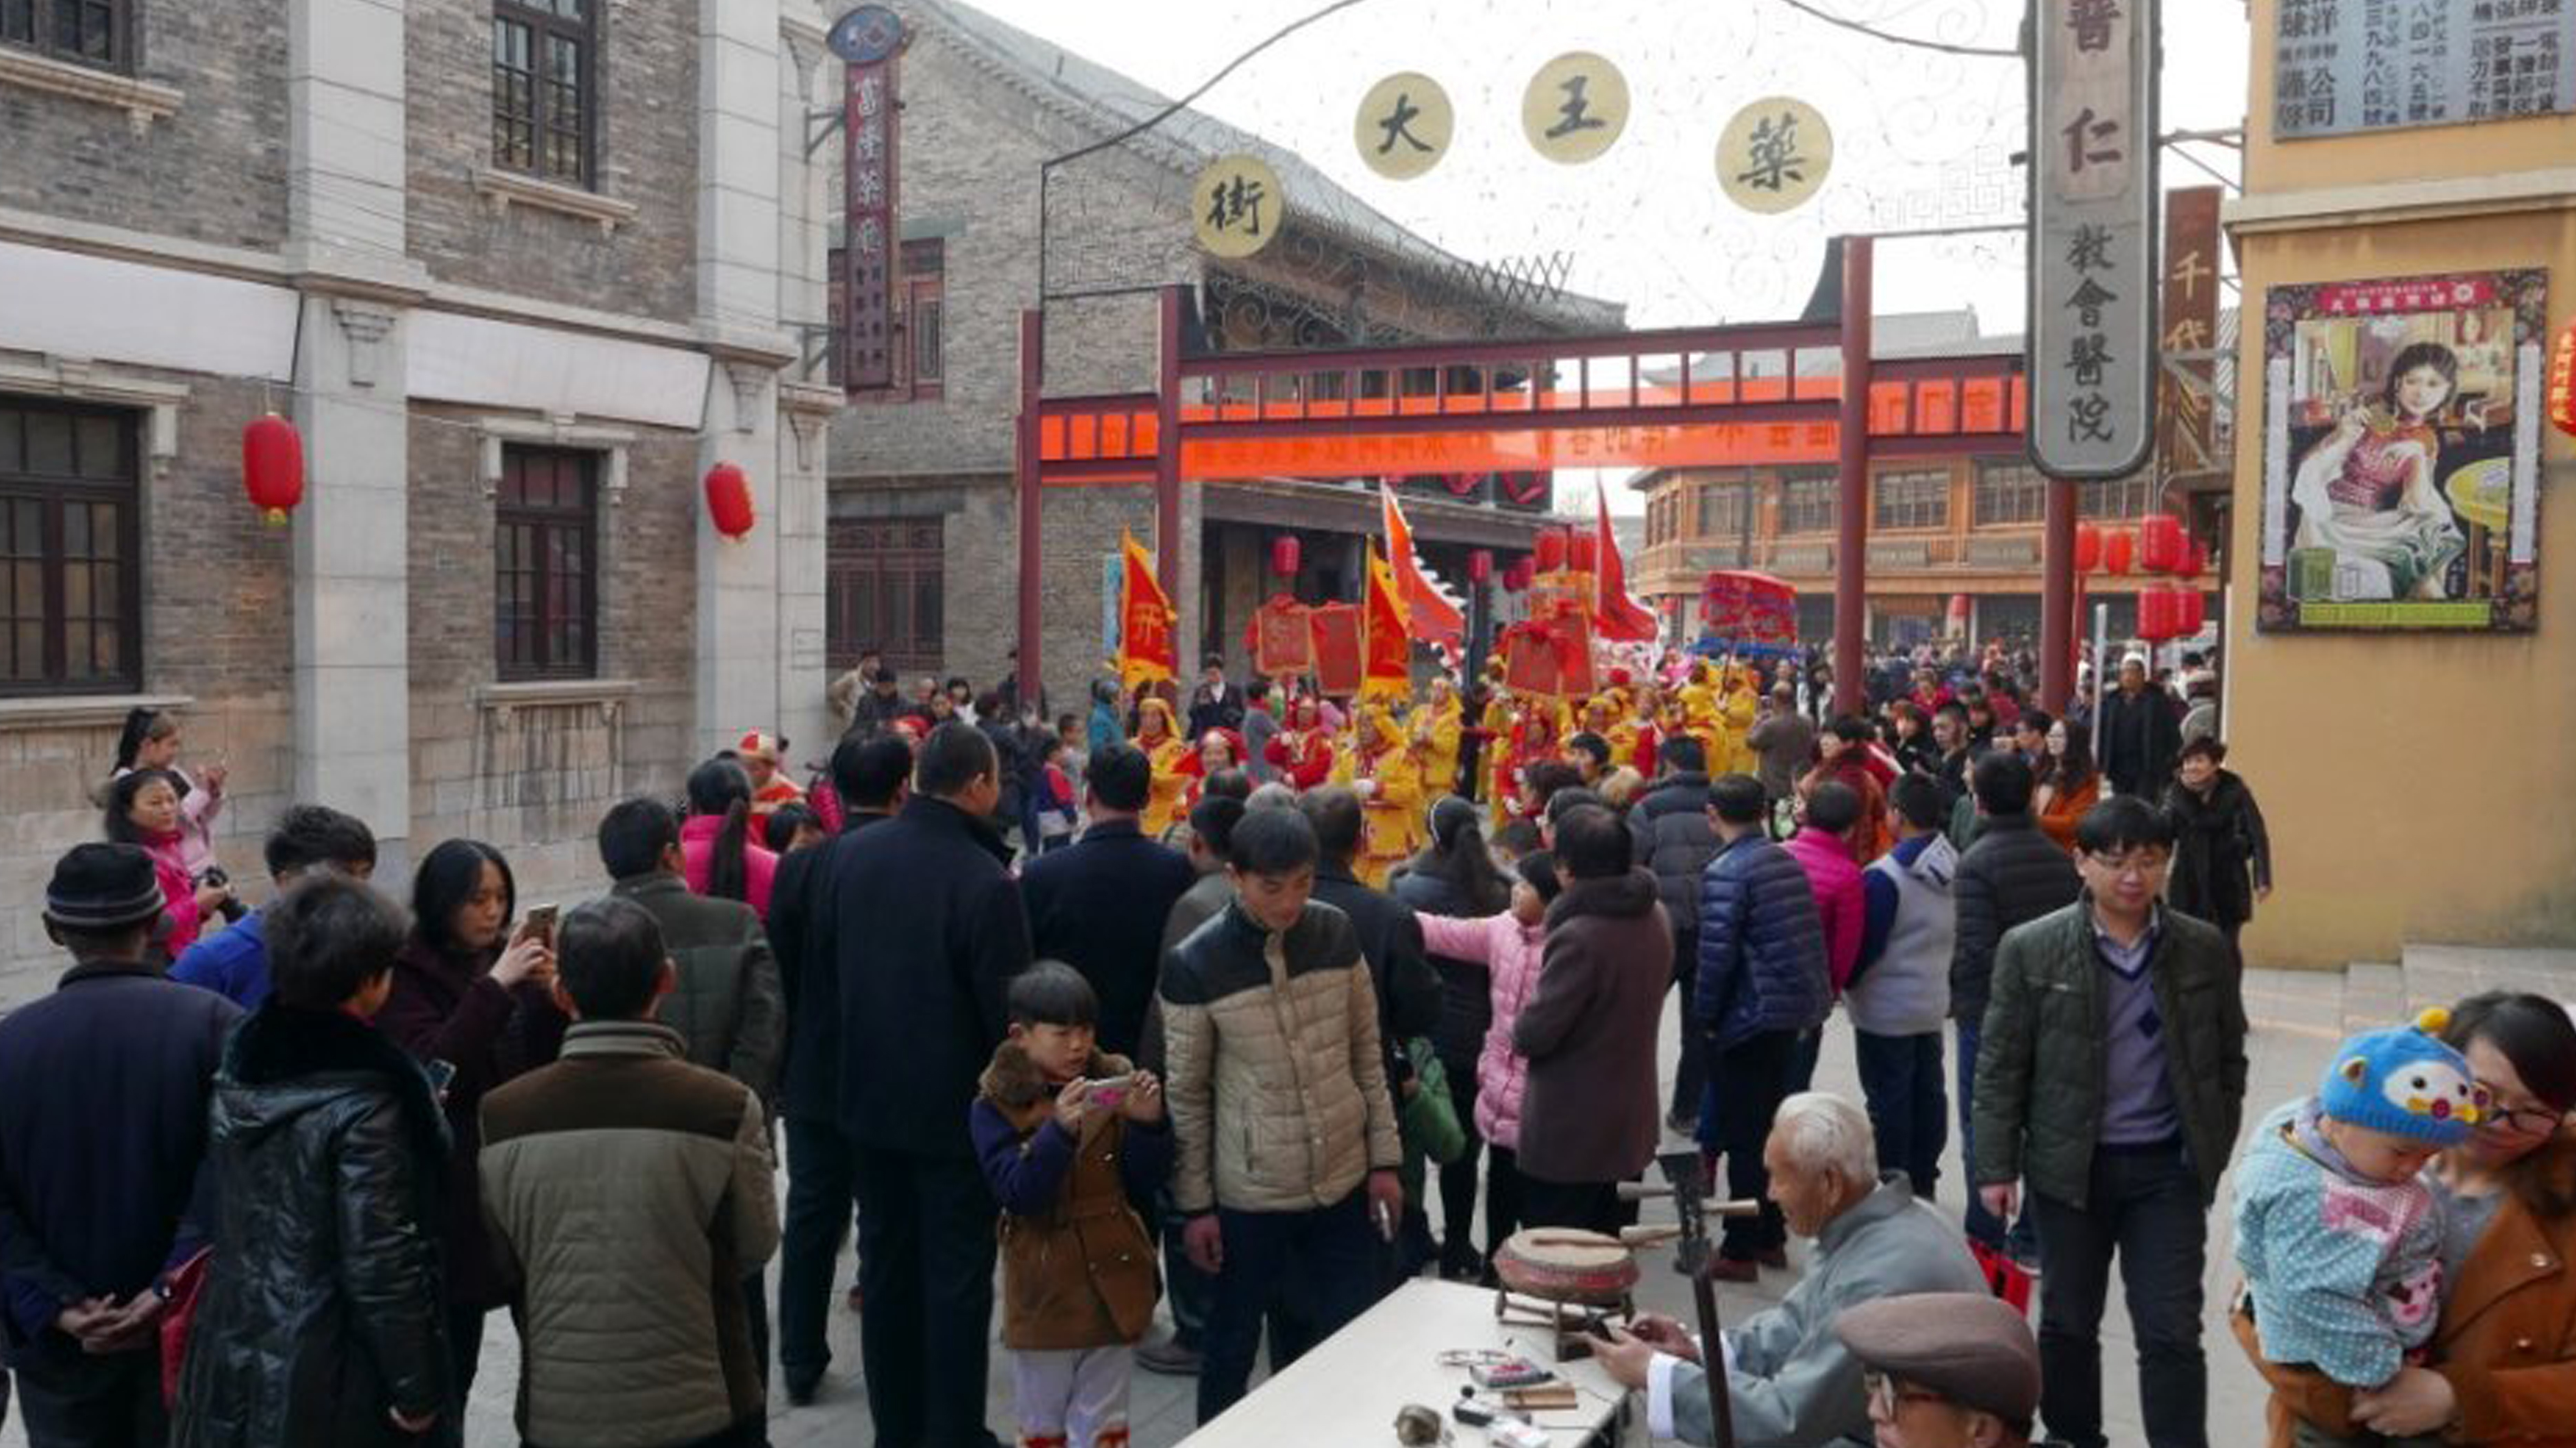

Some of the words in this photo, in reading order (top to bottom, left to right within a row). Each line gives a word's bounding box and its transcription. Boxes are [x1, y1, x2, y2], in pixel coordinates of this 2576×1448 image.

[1376, 93, 1434, 154] 大
[1545, 75, 1606, 139] 王
[1207, 175, 1263, 237] 街
